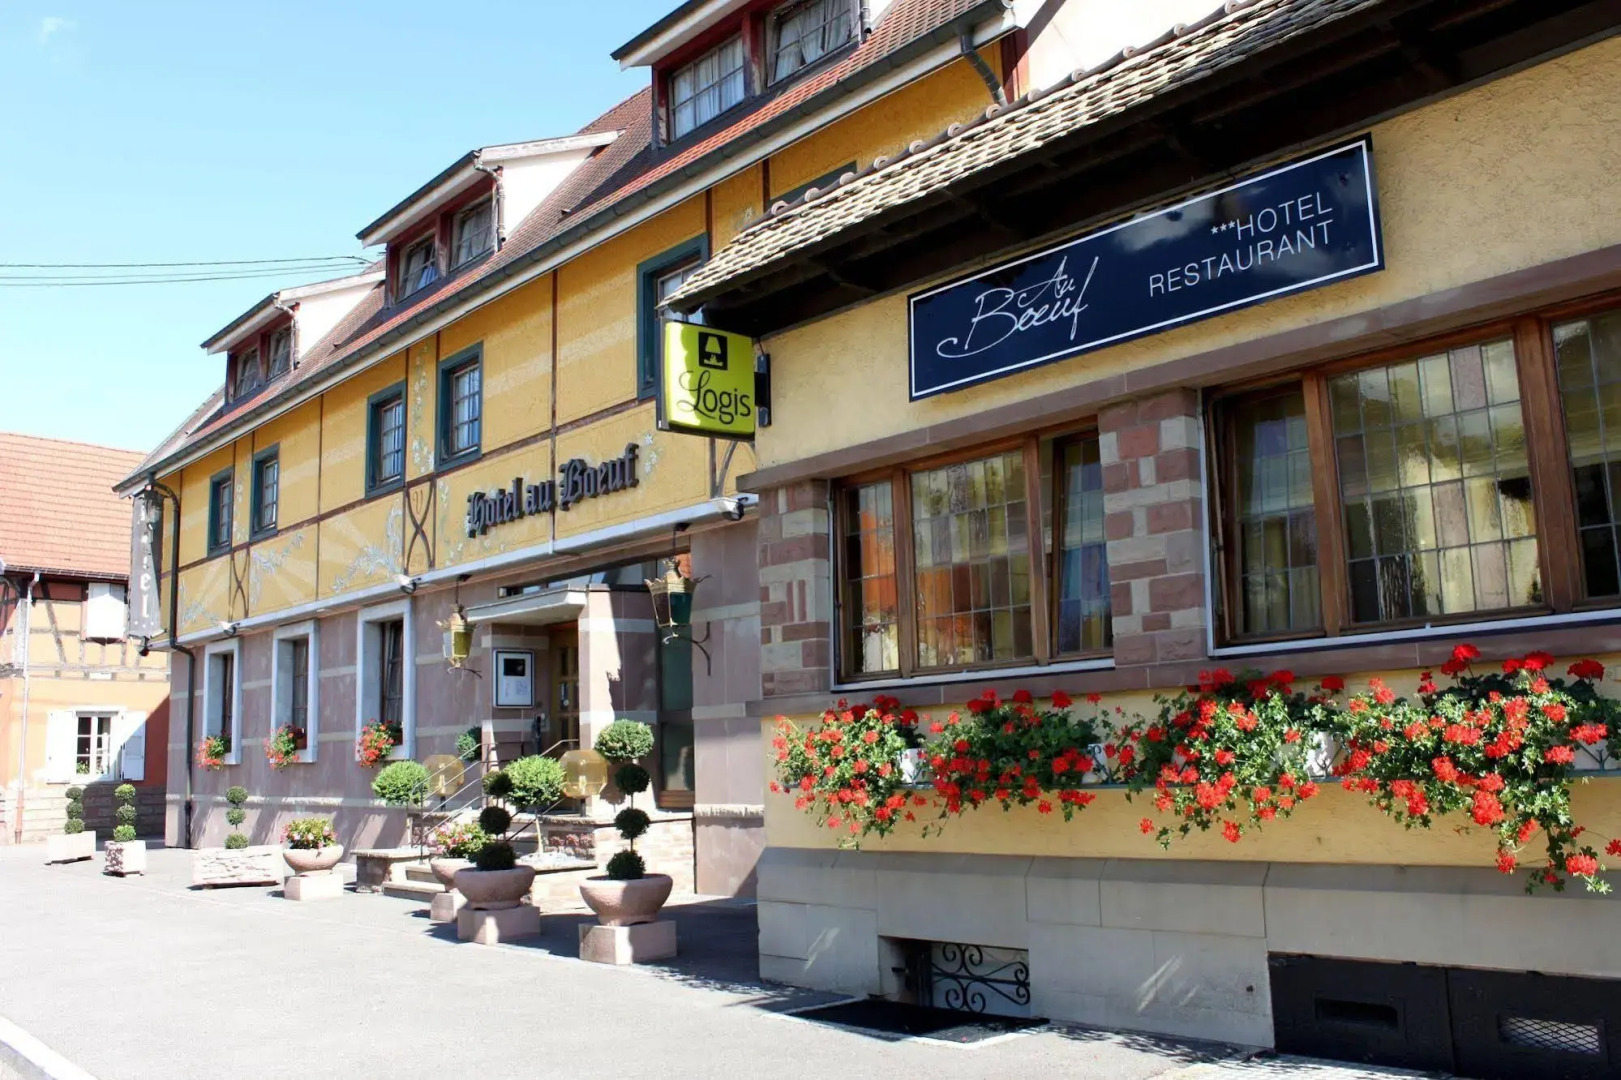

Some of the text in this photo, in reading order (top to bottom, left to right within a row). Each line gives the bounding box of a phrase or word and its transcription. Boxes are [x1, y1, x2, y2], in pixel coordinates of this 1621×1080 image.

[1005, 255, 1077, 308] Au
[1149, 218, 1334, 298] RESTAURANT
[676, 370, 751, 425] Logis
[467, 442, 640, 538] Hotel au Boeuf
